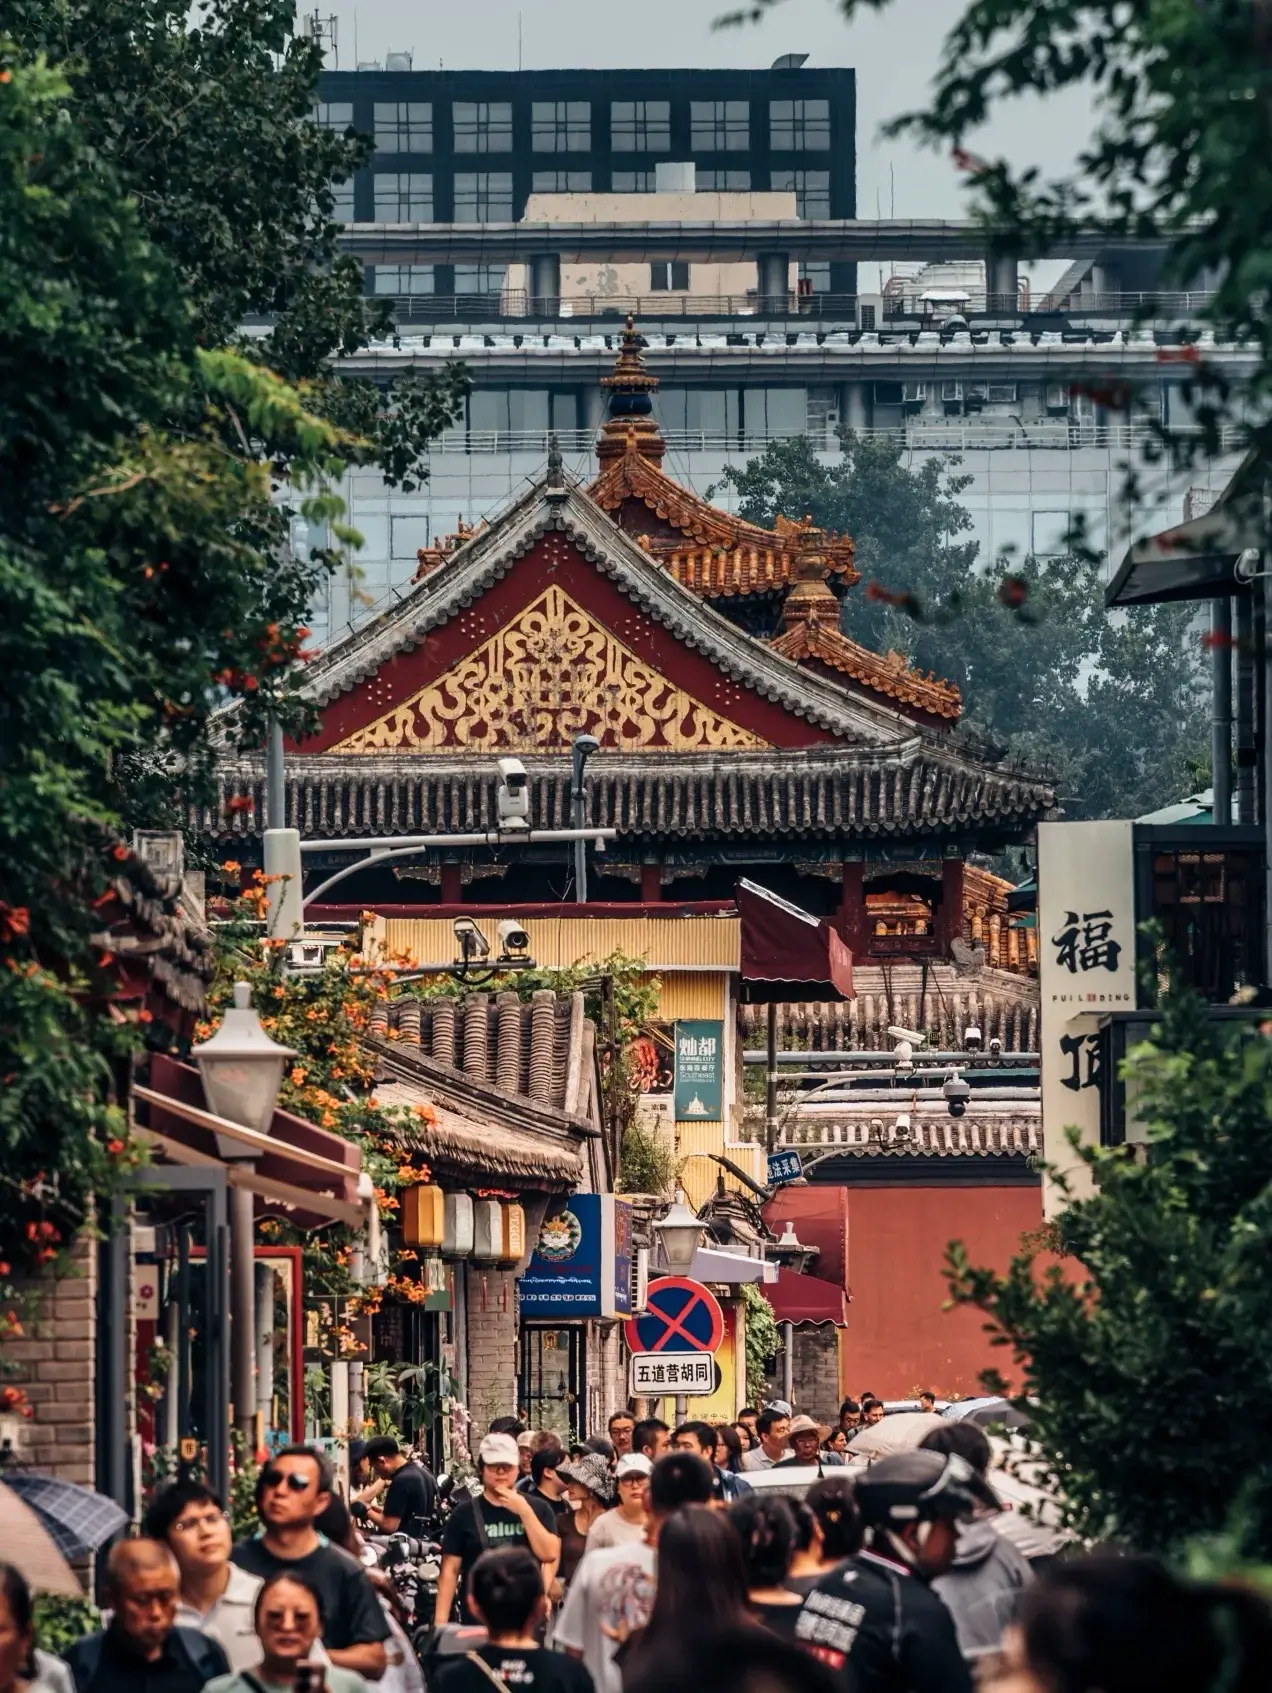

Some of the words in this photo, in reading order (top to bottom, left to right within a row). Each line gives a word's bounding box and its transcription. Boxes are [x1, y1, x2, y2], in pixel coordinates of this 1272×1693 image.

[1052, 909, 1122, 974] 福
[679, 1036, 717, 1057] 灿都
[637, 1362, 708, 1384] 五道营胡同
